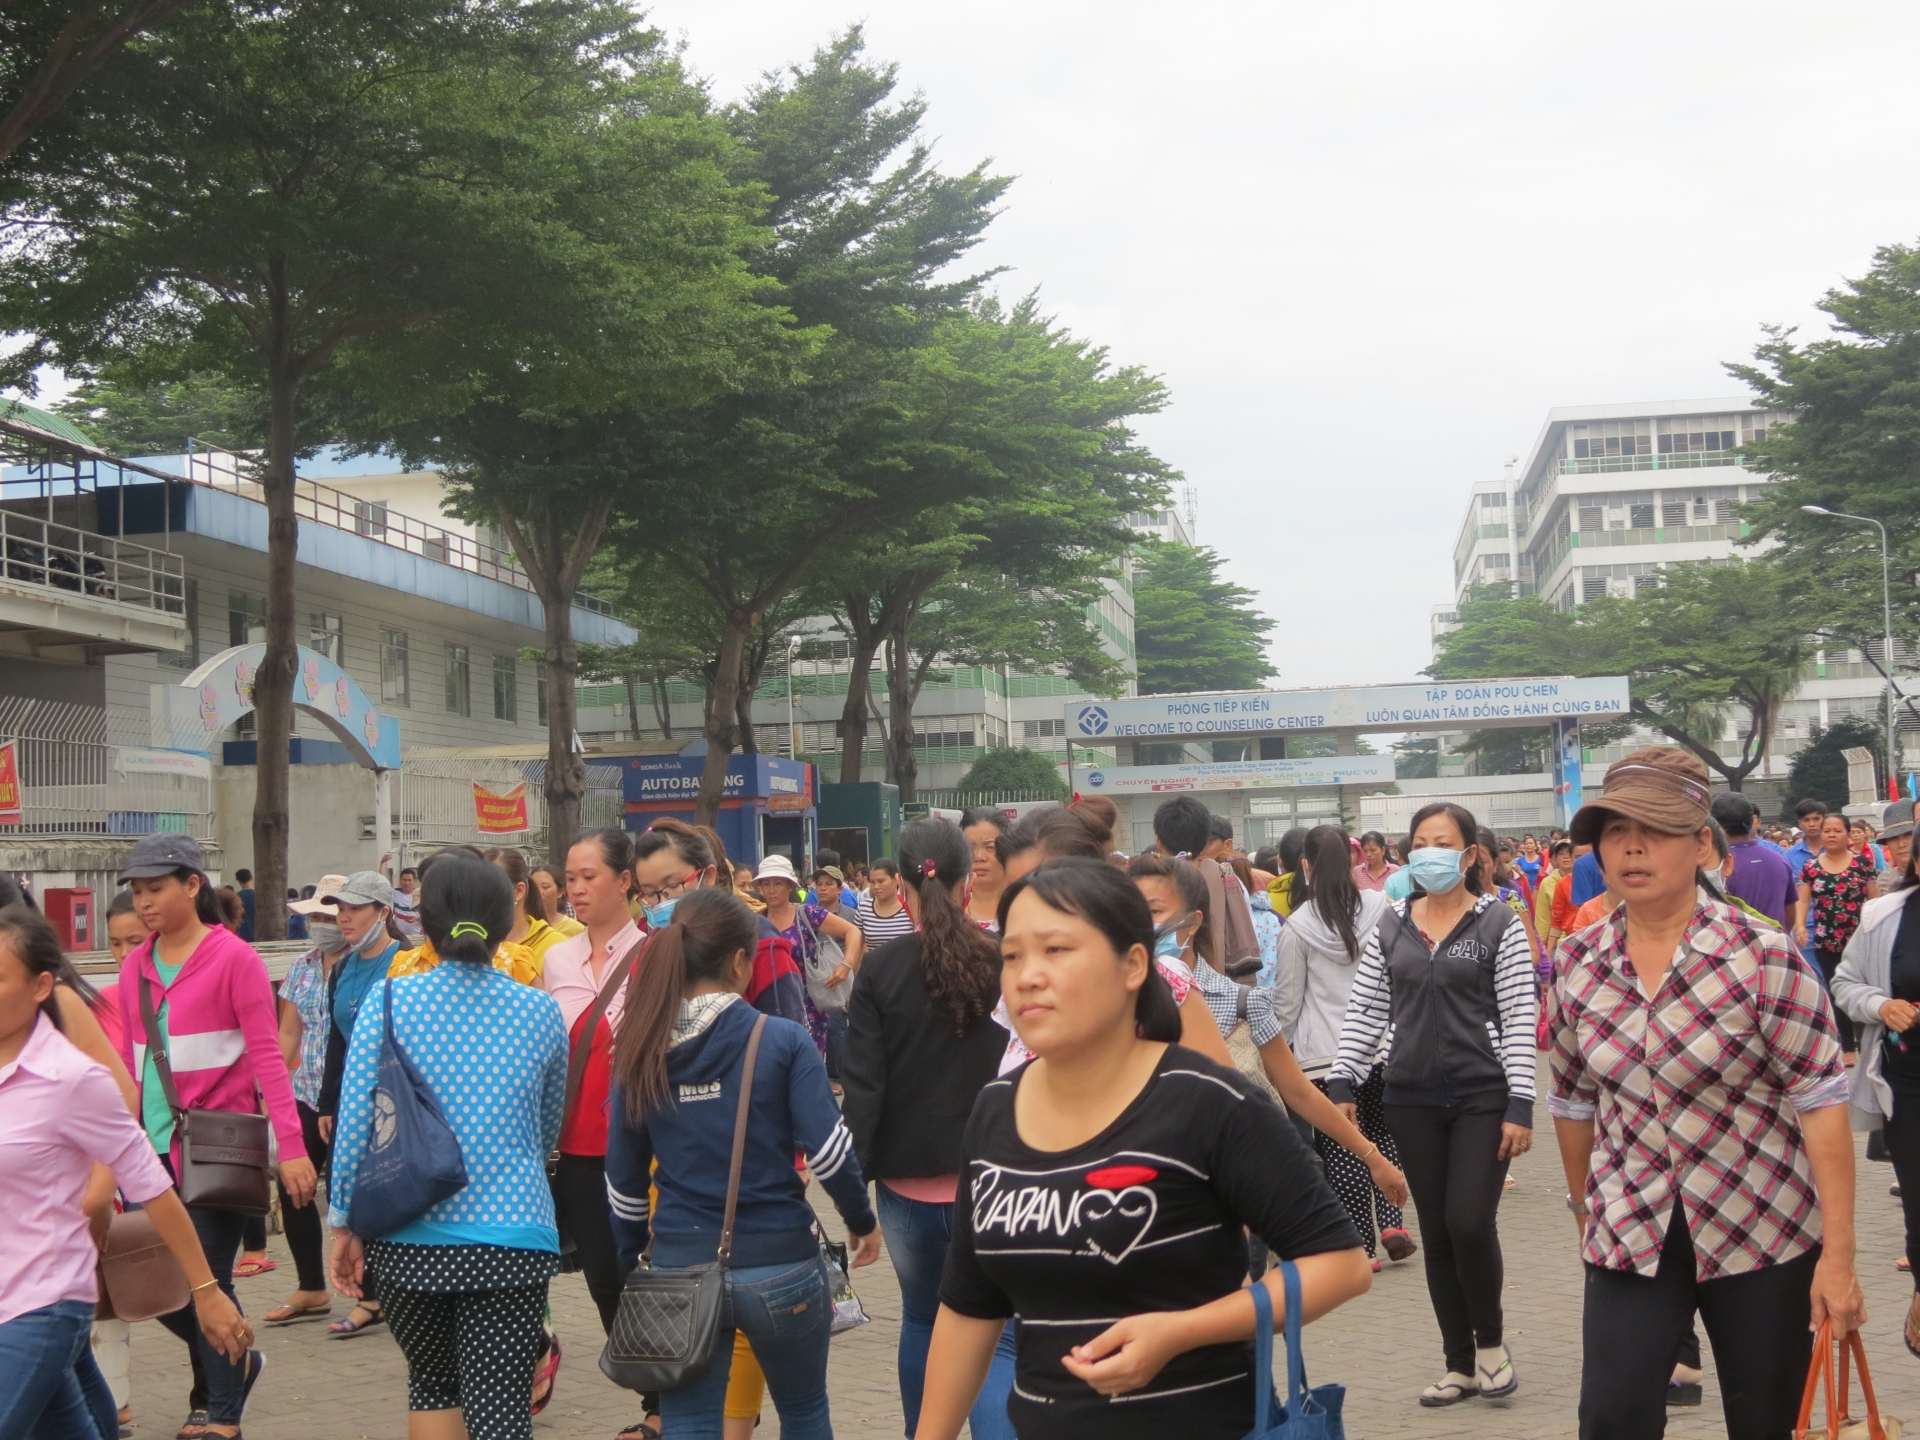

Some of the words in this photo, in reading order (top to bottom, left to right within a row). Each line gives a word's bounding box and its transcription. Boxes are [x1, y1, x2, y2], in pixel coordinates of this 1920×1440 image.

[1426, 688, 1448, 703] TẬP
[1455, 686, 1491, 701] ĐOÀN
[1495, 687, 1519, 699] POU
[1523, 685, 1559, 697] CHEN
[1167, 700, 1211, 716] PHÒNG
[1214, 698, 1238, 712] TIẾP
[1366, 708, 1399, 723] LUÔN
[1402, 708, 1440, 721] QUAN
[1443, 704, 1469, 719] TÂM
[1473, 701, 1510, 718] ĐỒNG
[1514, 699, 1549, 715] HÀNH
[1552, 697, 1591, 713] CÙNG
[1594, 699, 1621, 714] BẠN
[1114, 723, 1175, 737] WELCOME
[1178, 721, 1193, 734] TO
[1197, 717, 1274, 732] COUNSELING
[1277, 715, 1325, 729] CENTER
[641, 777, 680, 790] AUTO
[1447, 940, 1488, 963] GAP
[973, 1186, 1080, 1238] JAPAN
